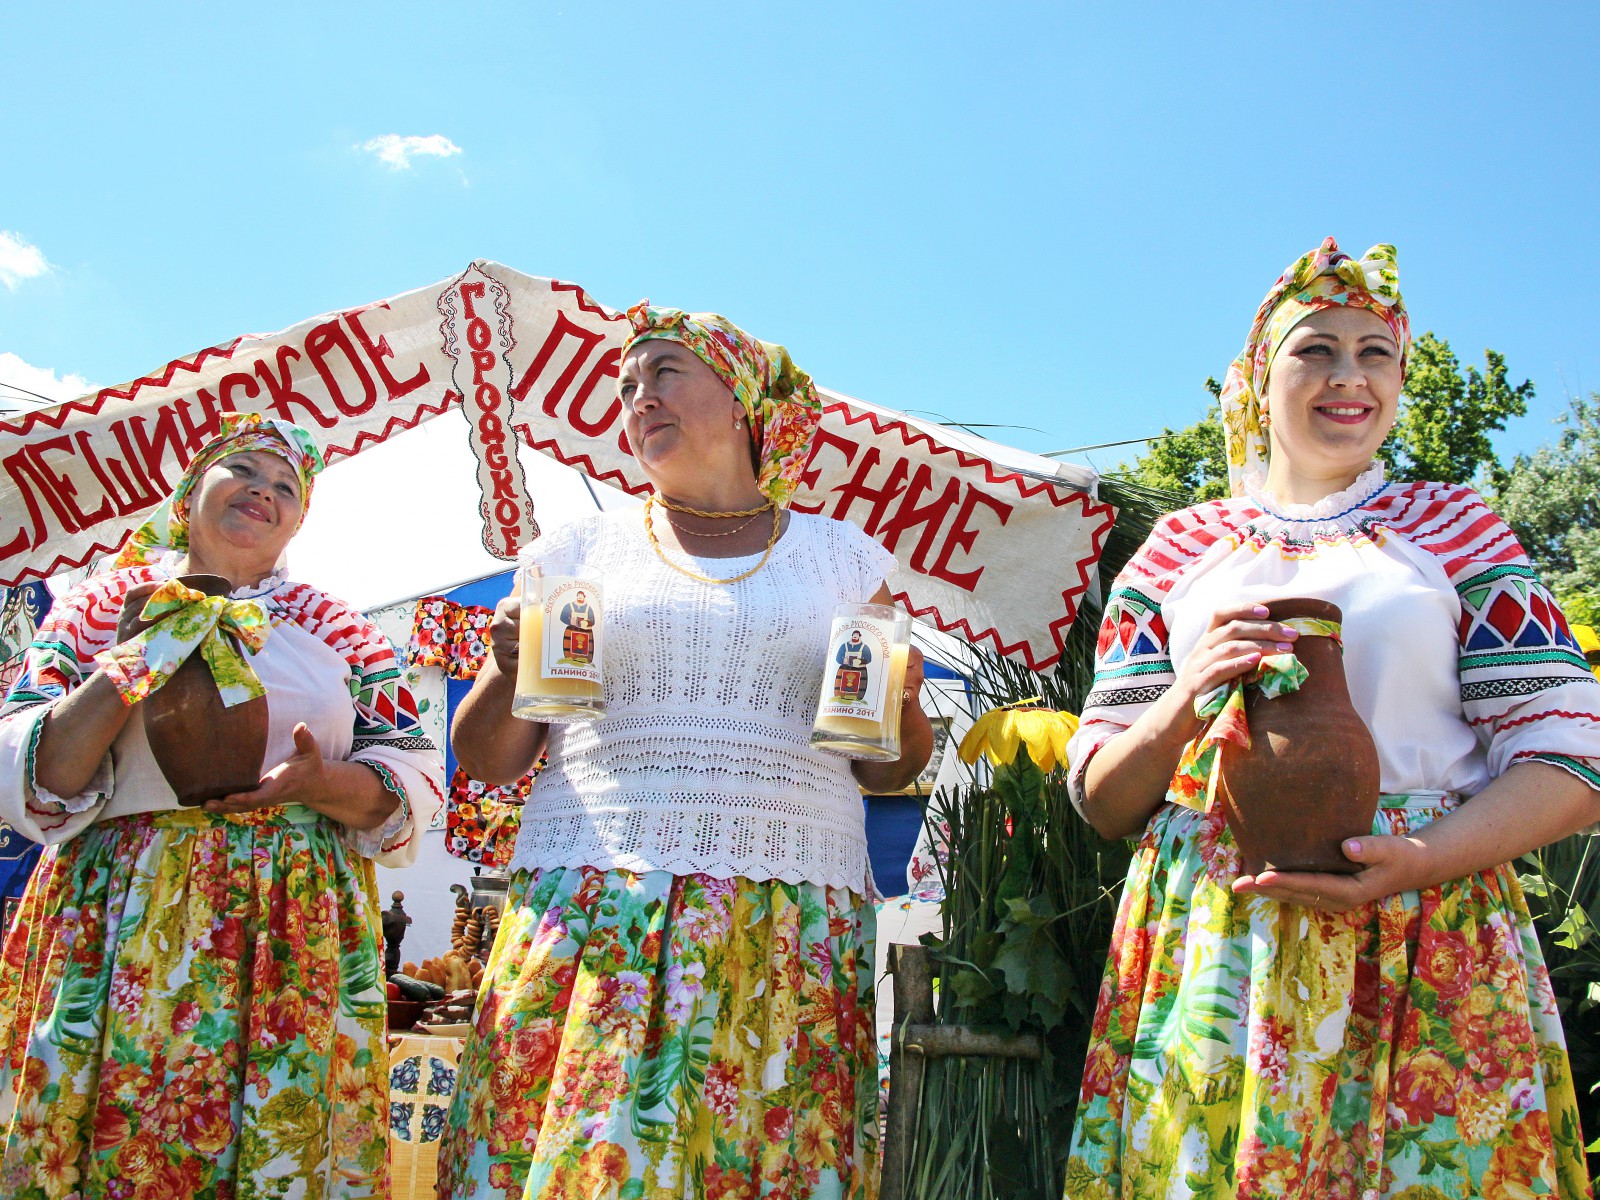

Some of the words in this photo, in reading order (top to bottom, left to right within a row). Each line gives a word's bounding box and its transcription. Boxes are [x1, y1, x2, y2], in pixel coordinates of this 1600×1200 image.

[460, 281, 523, 557] ГОРОДСКОЕ
[509, 309, 1014, 593] ПОЕНИЕ
[550, 668, 587, 677] ПАНИНО
[822, 707, 854, 715] ПАНИНО
[856, 709, 875, 718] 2011
